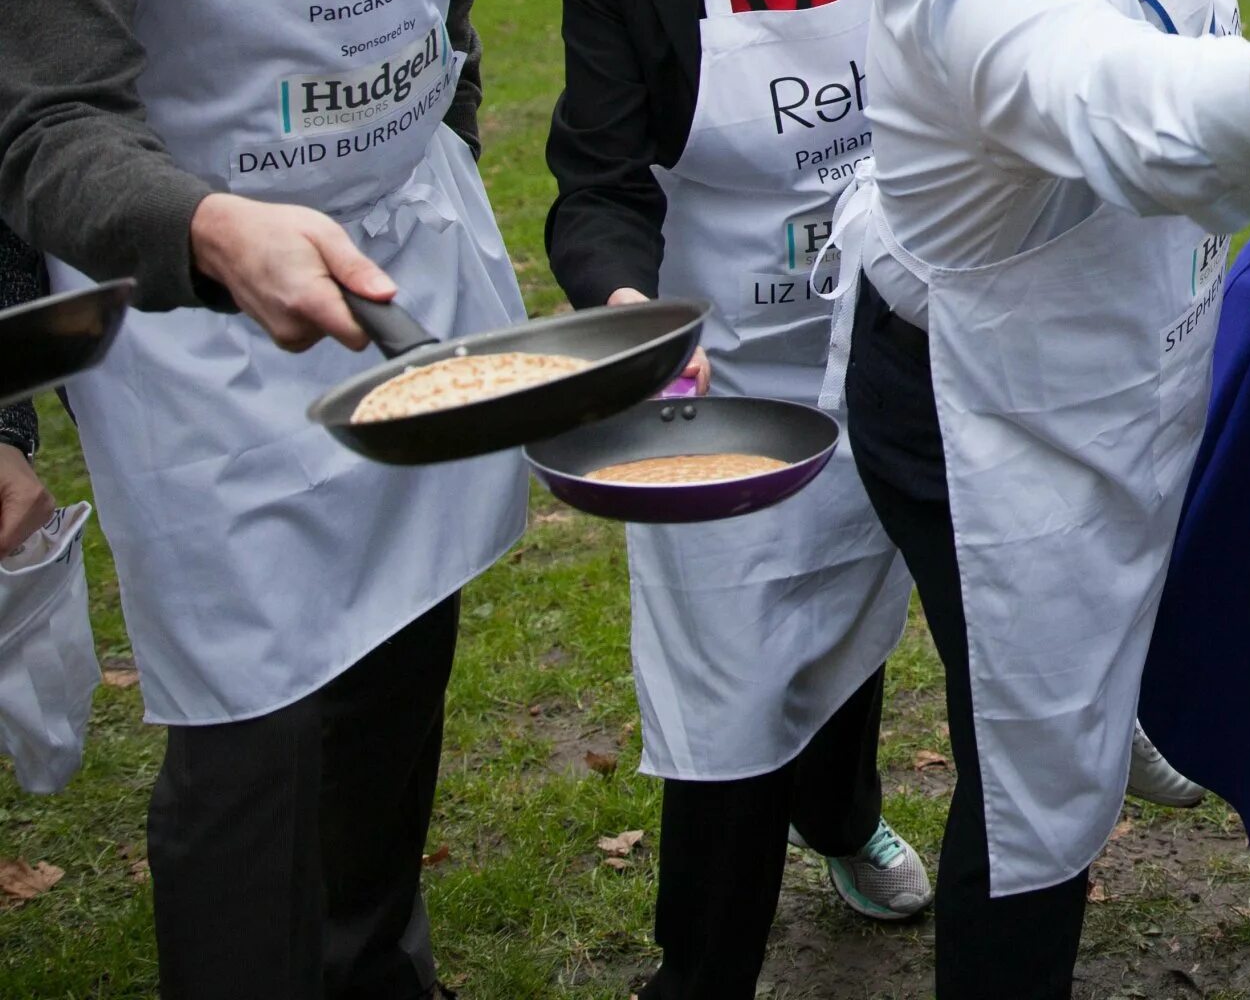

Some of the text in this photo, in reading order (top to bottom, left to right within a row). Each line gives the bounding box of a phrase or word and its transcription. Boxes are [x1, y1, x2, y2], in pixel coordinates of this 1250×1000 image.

[341, 18, 416, 57] Sponsored by
[301, 28, 439, 114] Hudgell
[239, 83, 441, 173] DAVID BURROWES
[304, 101, 389, 128] SOLICITORS
[755, 282, 795, 304] LIZ
[1165, 266, 1223, 352] STEPHEN
